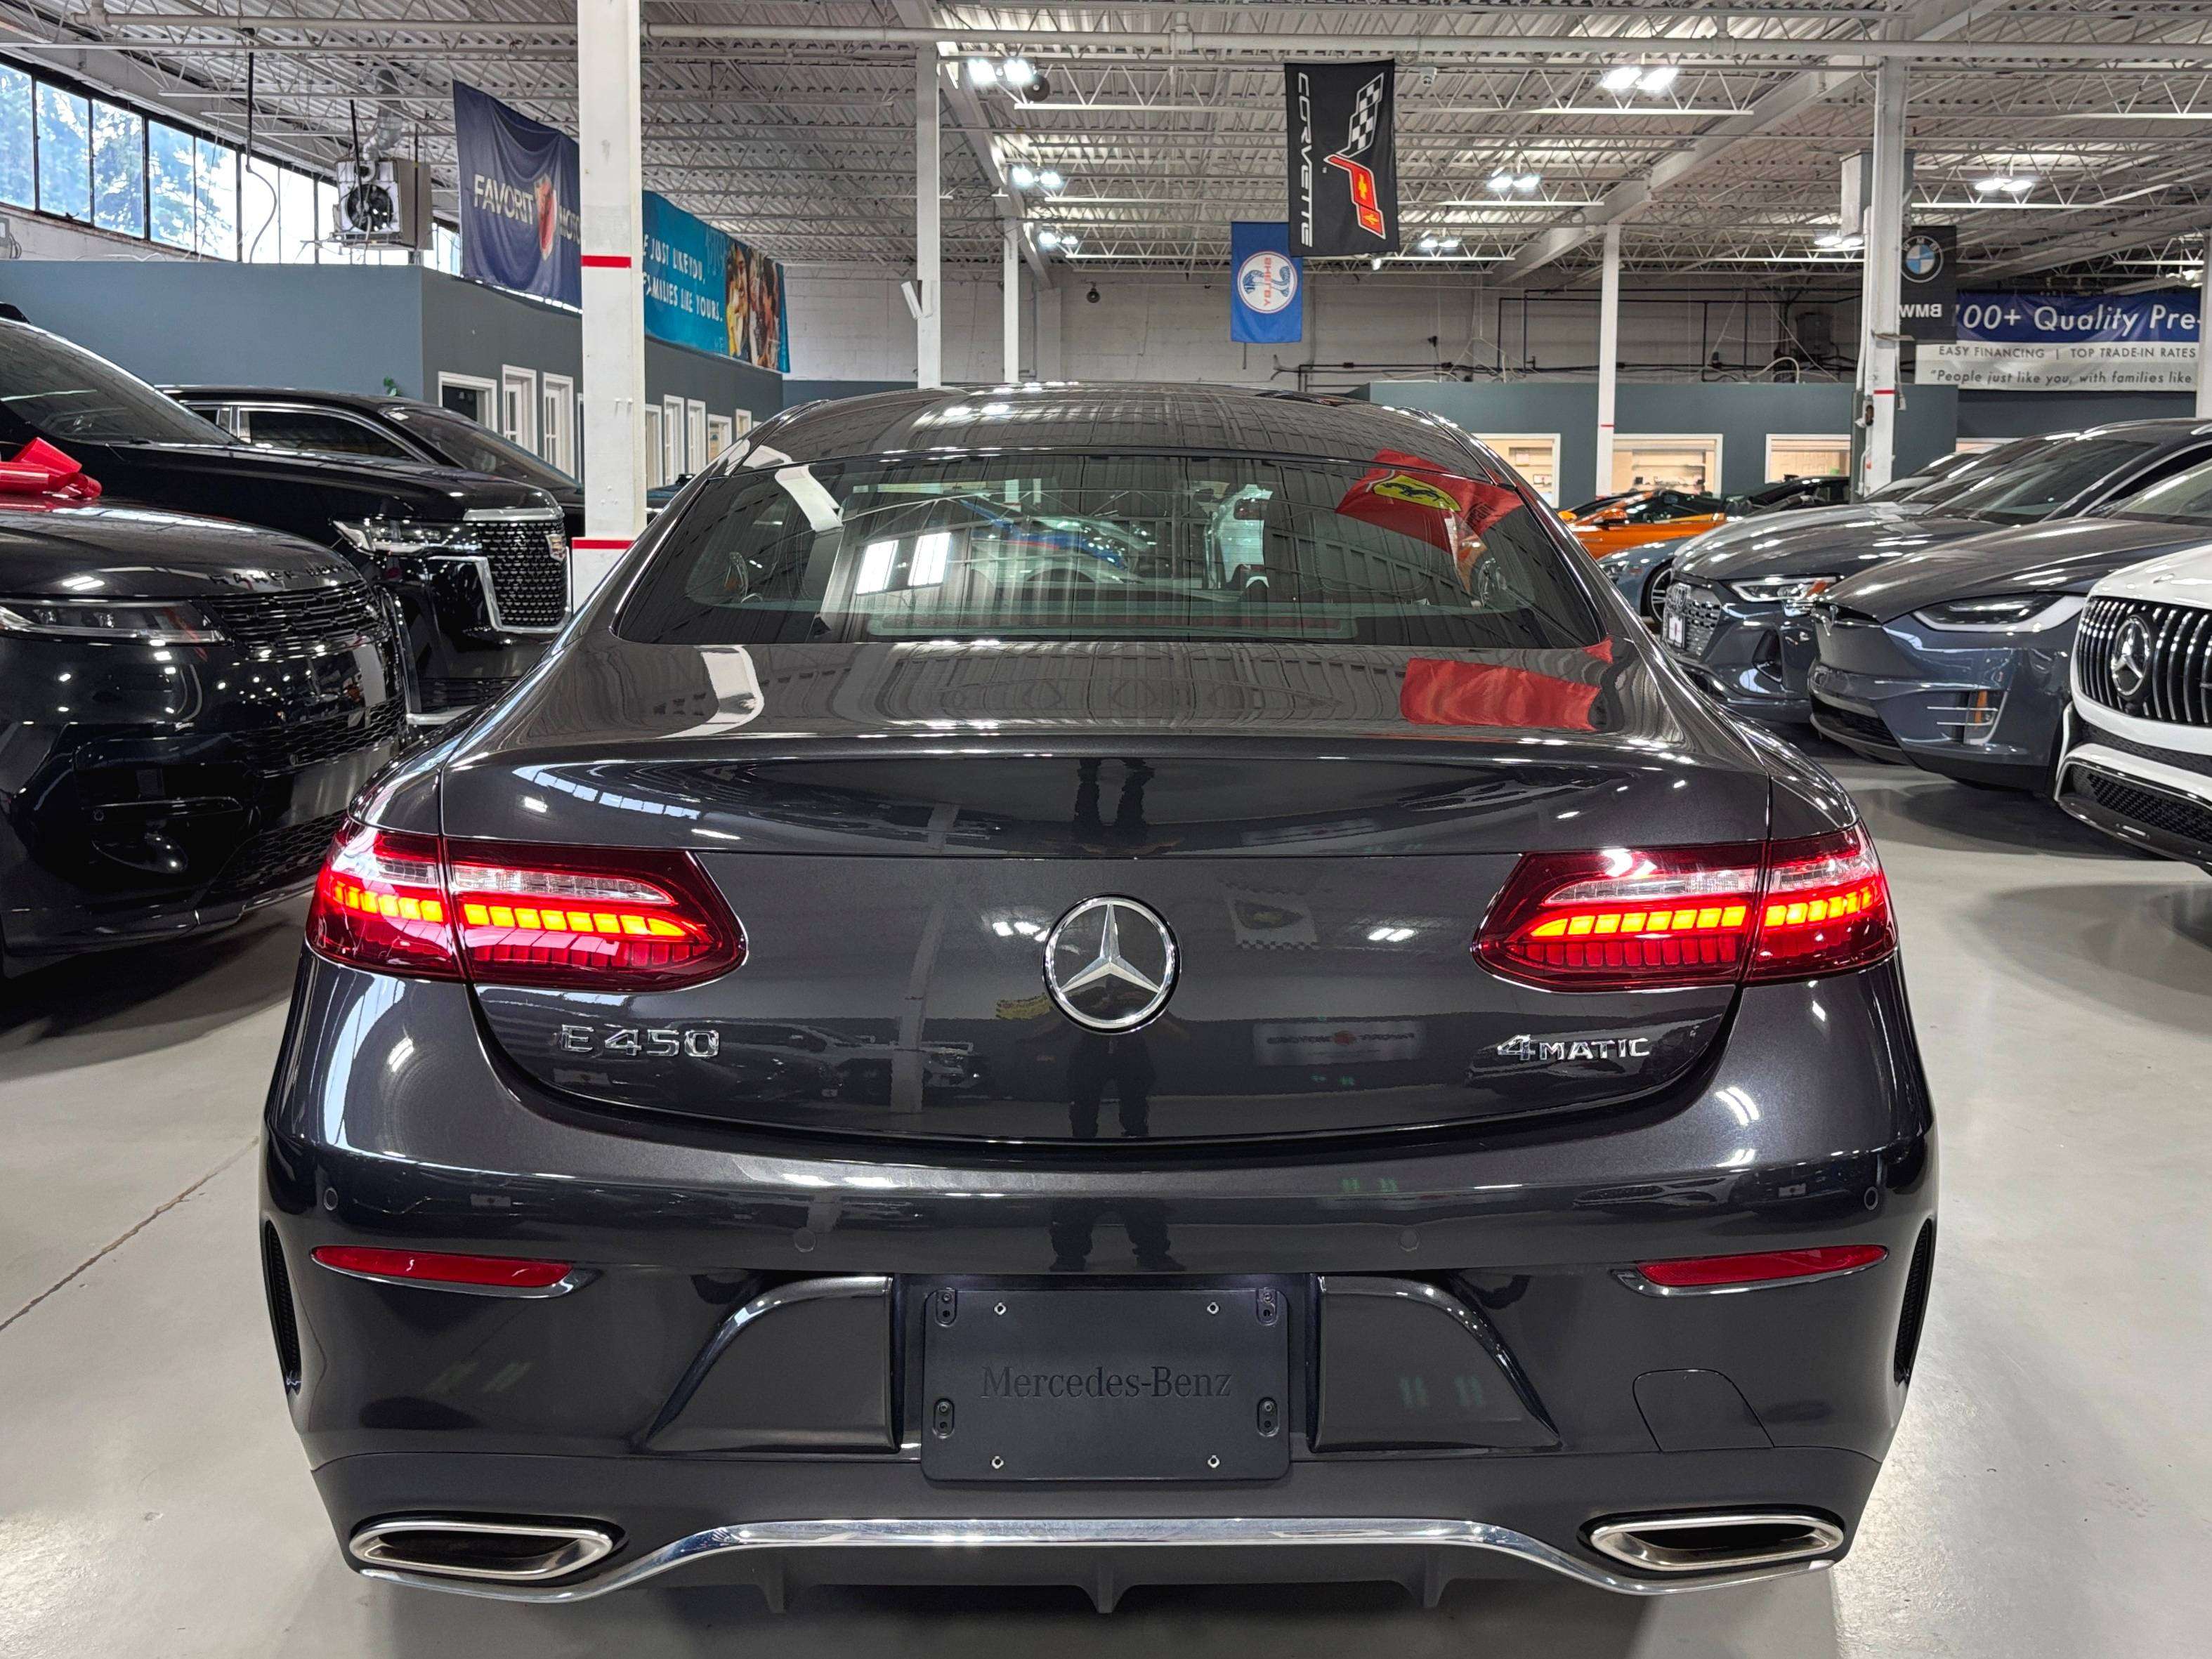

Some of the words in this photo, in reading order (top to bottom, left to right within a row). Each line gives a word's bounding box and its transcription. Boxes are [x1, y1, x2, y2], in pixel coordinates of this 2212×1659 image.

[1298, 72, 1313, 247] CORVETTE
[474, 173, 533, 225] FAVORIT
[650, 238, 669, 265] JUST
[673, 247, 688, 274] LIKE
[2034, 304, 2139, 337] Quality
[1939, 346, 1970, 357] EASY
[1975, 347, 2046, 358] FINANCING
[2072, 348, 2095, 358] TOP
[2101, 347, 2154, 358] TRADE-IN
[2160, 348, 2197, 358] RATES
[1987, 371, 2013, 383] just
[2017, 372, 2041, 383] like
[2079, 371, 2107, 383] with
[2112, 370, 2164, 383] families
[2168, 371, 2192, 383] like
[561, 1024, 594, 1052] E
[605, 1028, 719, 1057] 450
[1498, 1034, 1650, 1061] 4MATIC
[981, 1365, 1232, 1398] Mercedes-Benz
